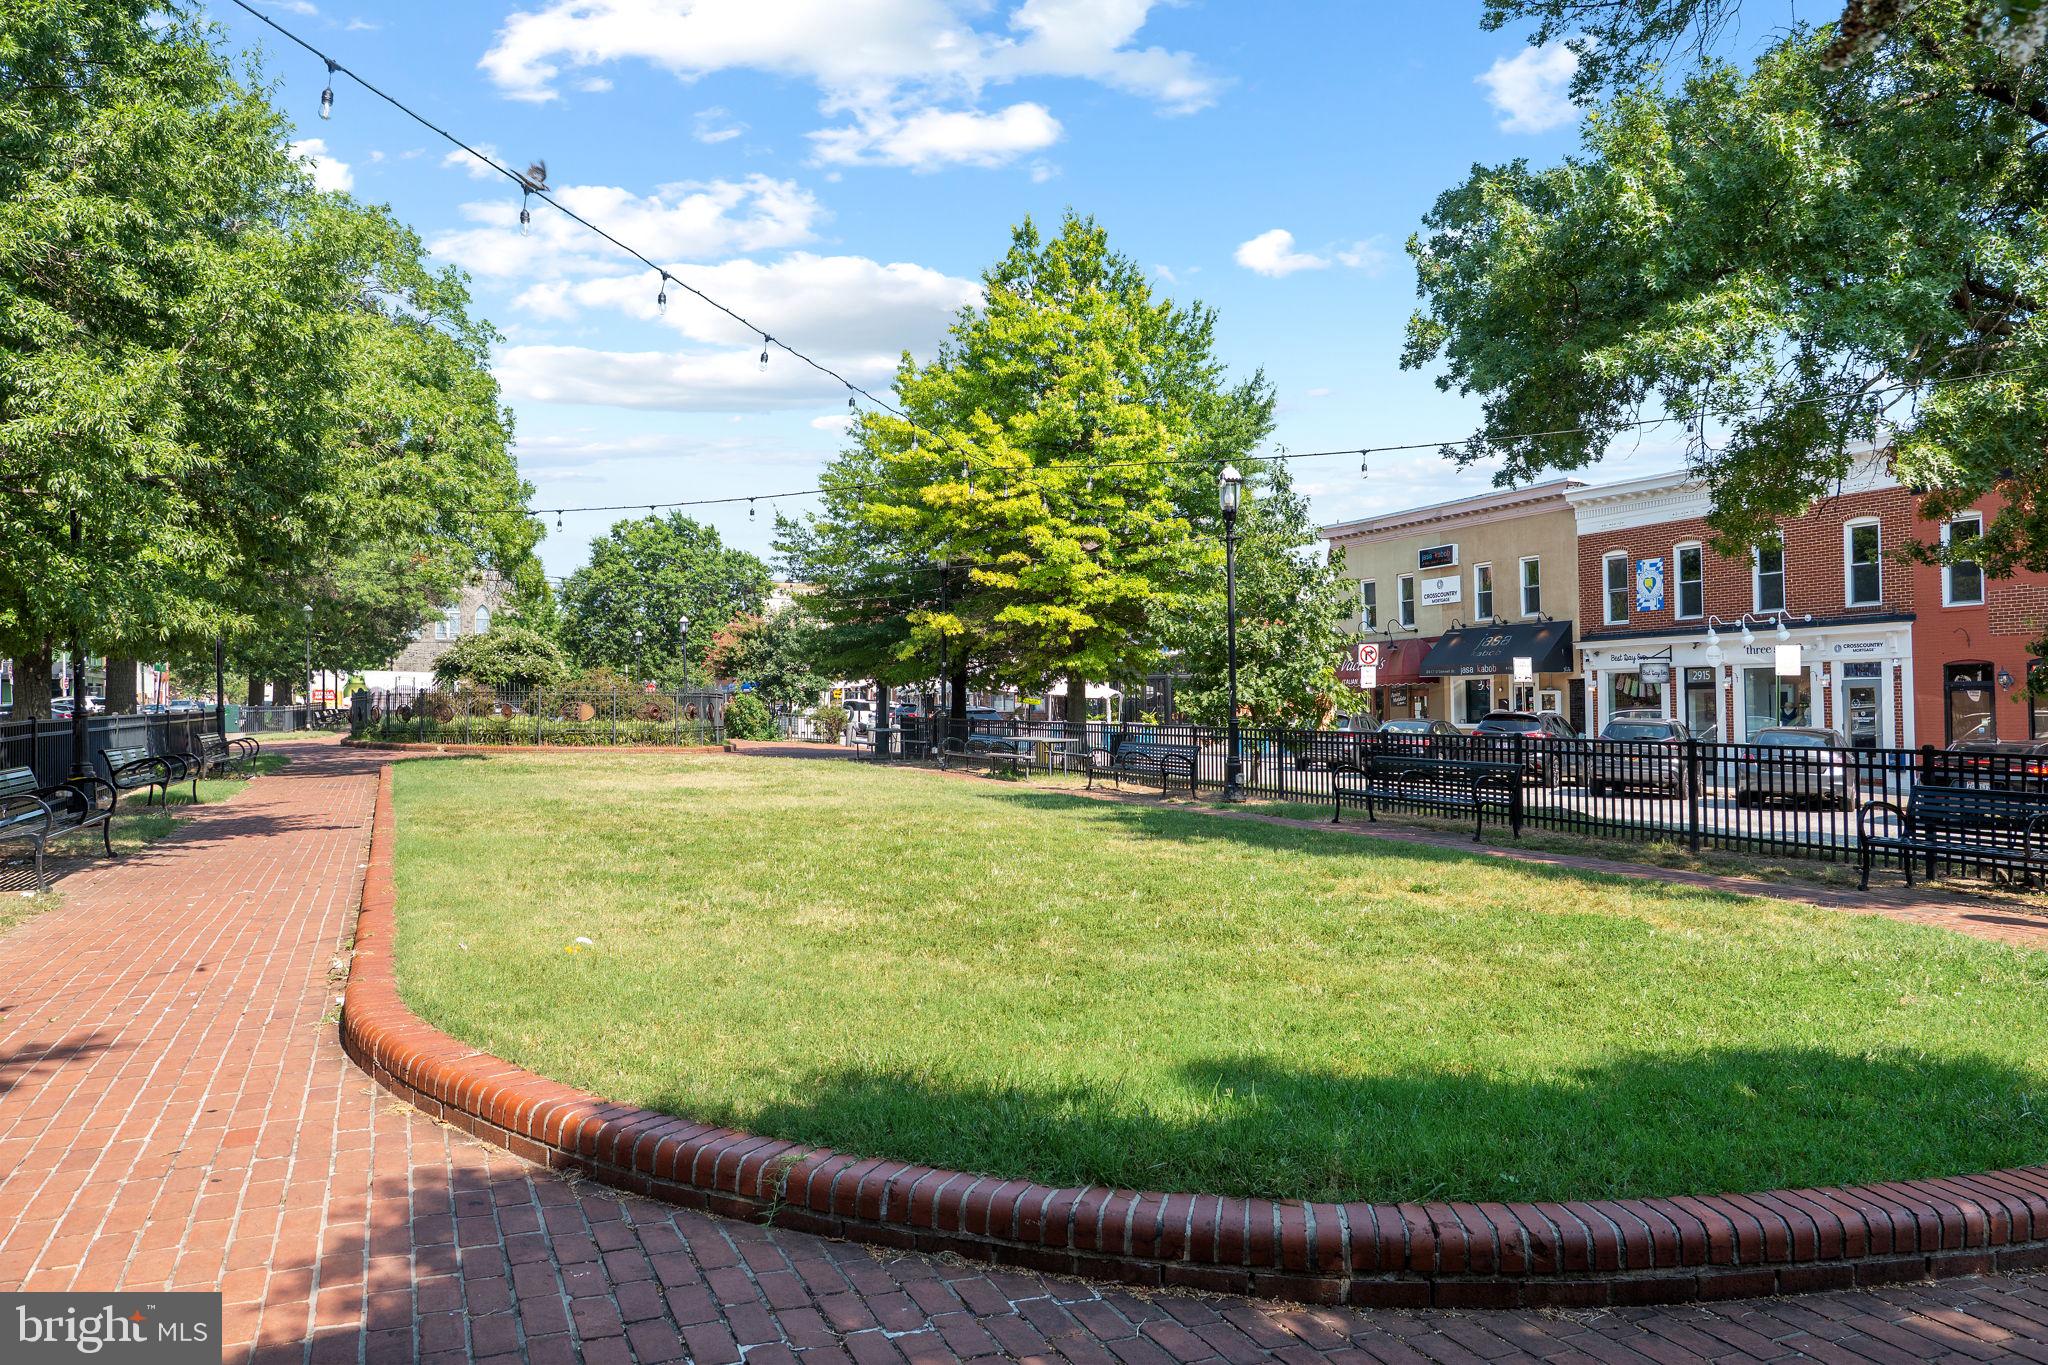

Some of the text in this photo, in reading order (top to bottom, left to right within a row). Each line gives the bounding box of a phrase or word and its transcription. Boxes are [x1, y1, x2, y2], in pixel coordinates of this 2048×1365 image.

[1423, 591, 1457, 600] CROSSCOUNTRY
[1476, 633, 1512, 650] jasa
[1624, 653, 1636, 664] Day
[1460, 665, 1475, 675] jasa
[1476, 664, 1497, 673] kabob
[1692, 670, 1711, 680] 2915
